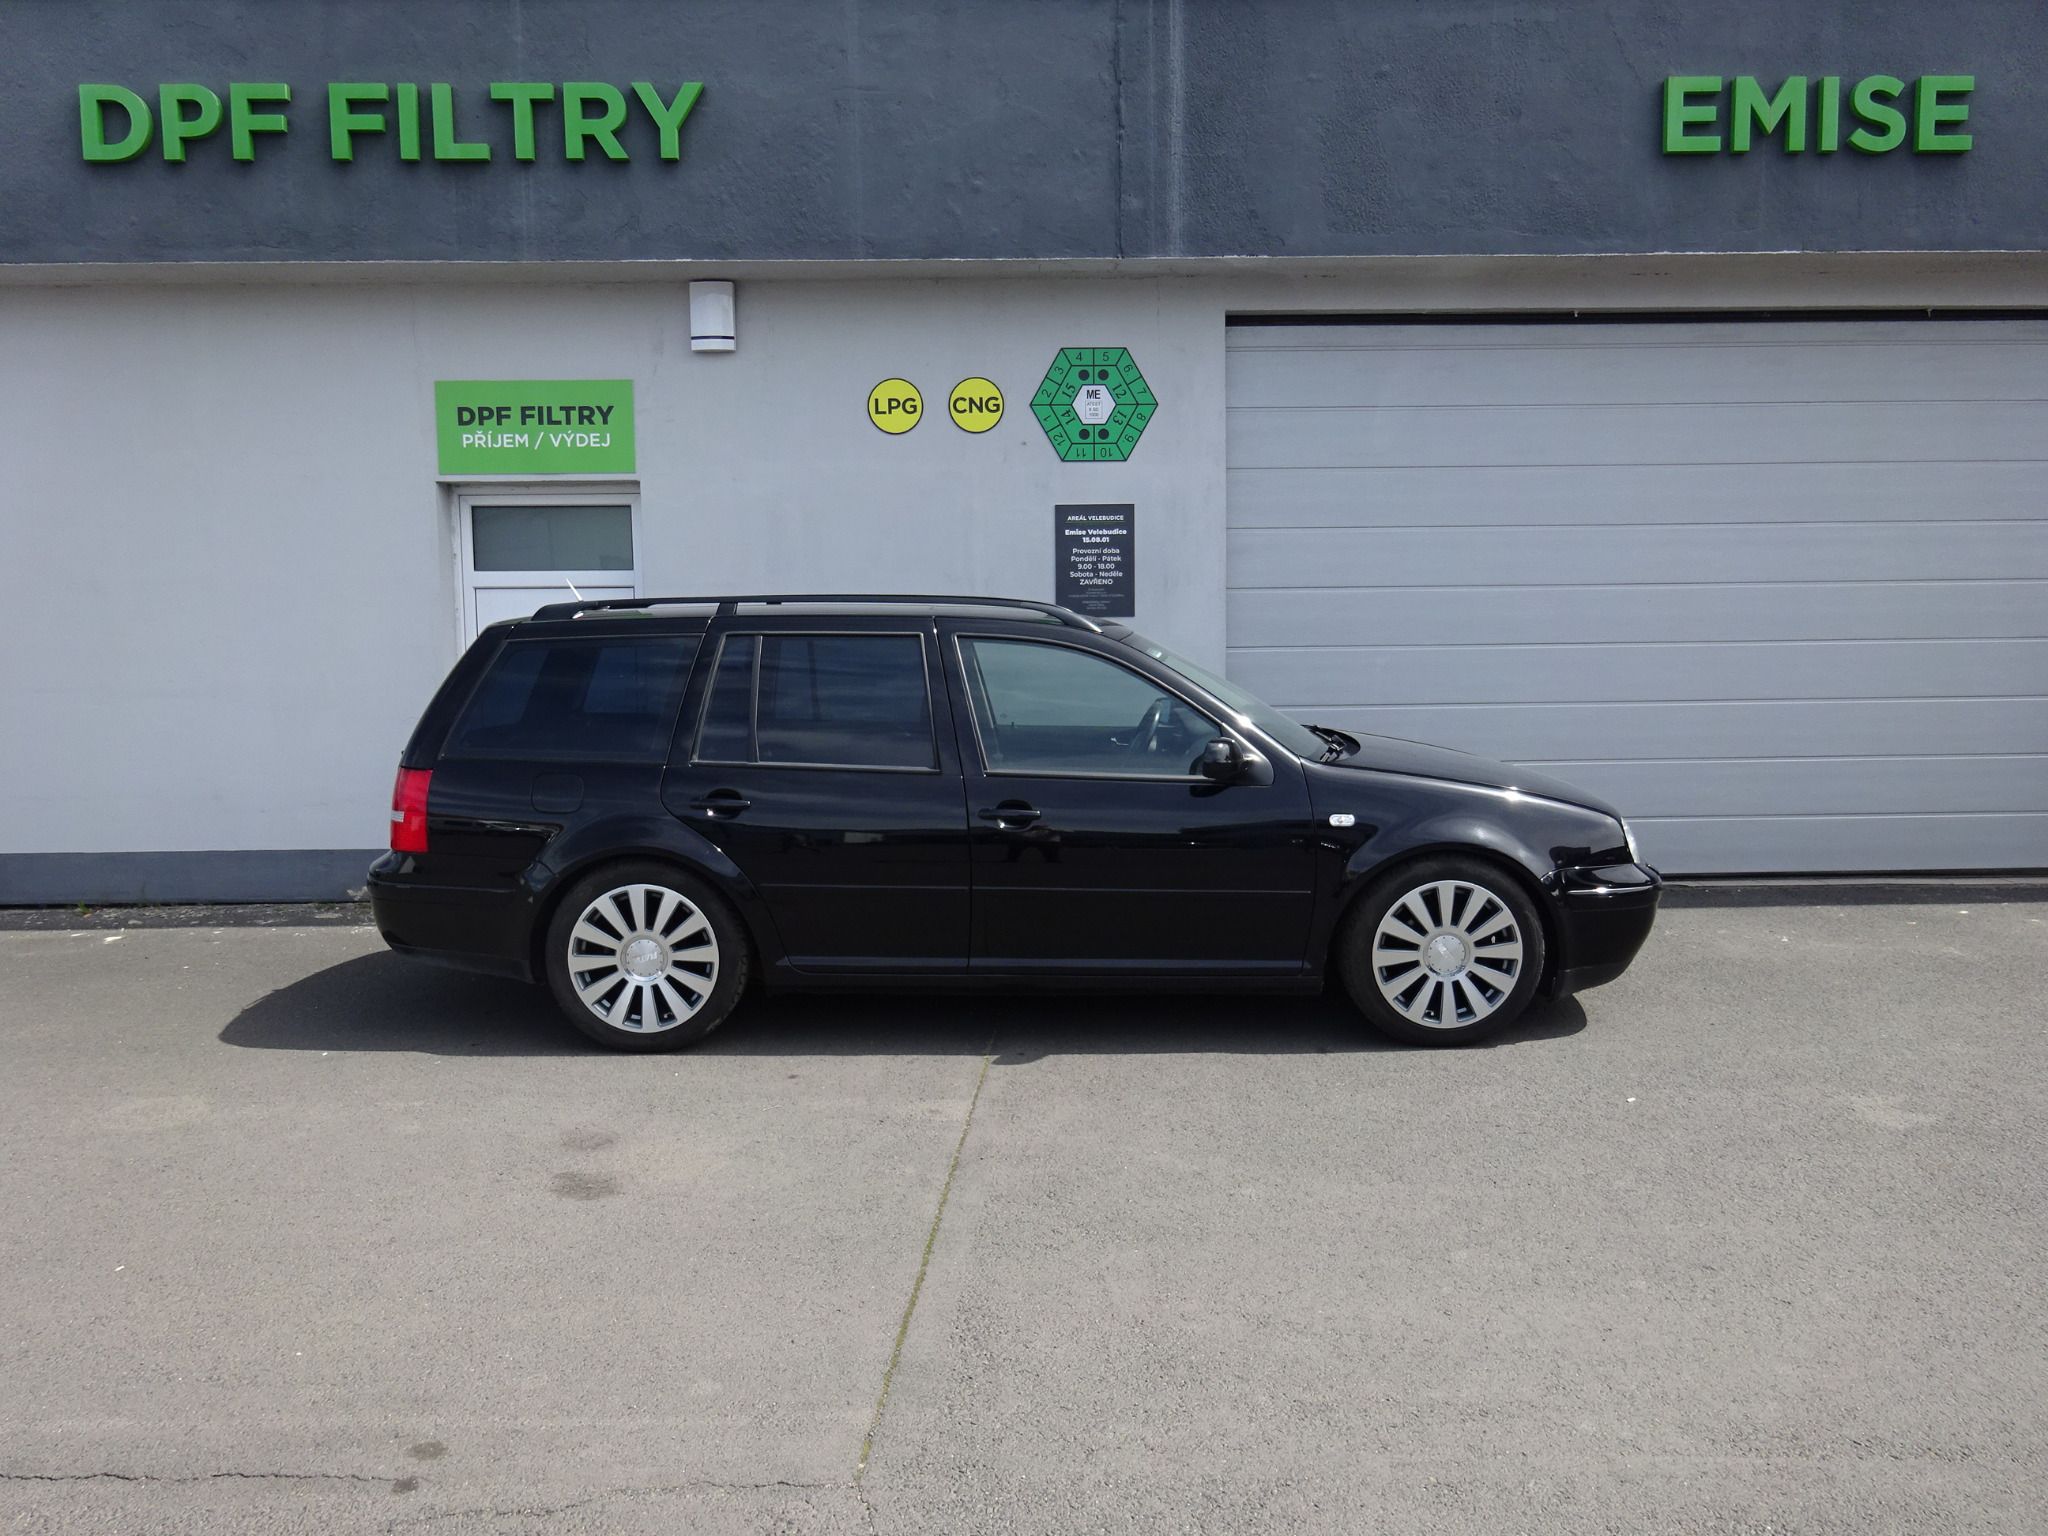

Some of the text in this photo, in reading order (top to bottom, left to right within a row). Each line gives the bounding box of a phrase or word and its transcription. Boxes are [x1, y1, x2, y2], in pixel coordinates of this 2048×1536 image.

[79, 81, 705, 162] DPF FILTRY
[1663, 75, 1975, 154] EMISE
[1075, 352, 1082, 361] 4
[1102, 352, 1110, 361] 5
[1054, 366, 1064, 375] 3
[1042, 388, 1052, 398] 2
[1062, 383, 1076, 399] 15
[1086, 389, 1101, 399] ME
[1112, 384, 1127, 399] 12
[874, 397, 917, 415] LPG
[952, 396, 1001, 414] CNG
[457, 405, 614, 426] DPF FILTRY
[1042, 414, 1052, 422] 1
[1061, 409, 1076, 425] 14
[1112, 410, 1127, 425] 13
[1136, 412, 1146, 422] 8
[462, 430, 529, 448] PŘÍJEM
[550, 430, 611, 448] VÝDEJ
[1053, 432, 1066, 446] 12
[1076, 448, 1087, 457] 11
[1100, 448, 1113, 458] 10
